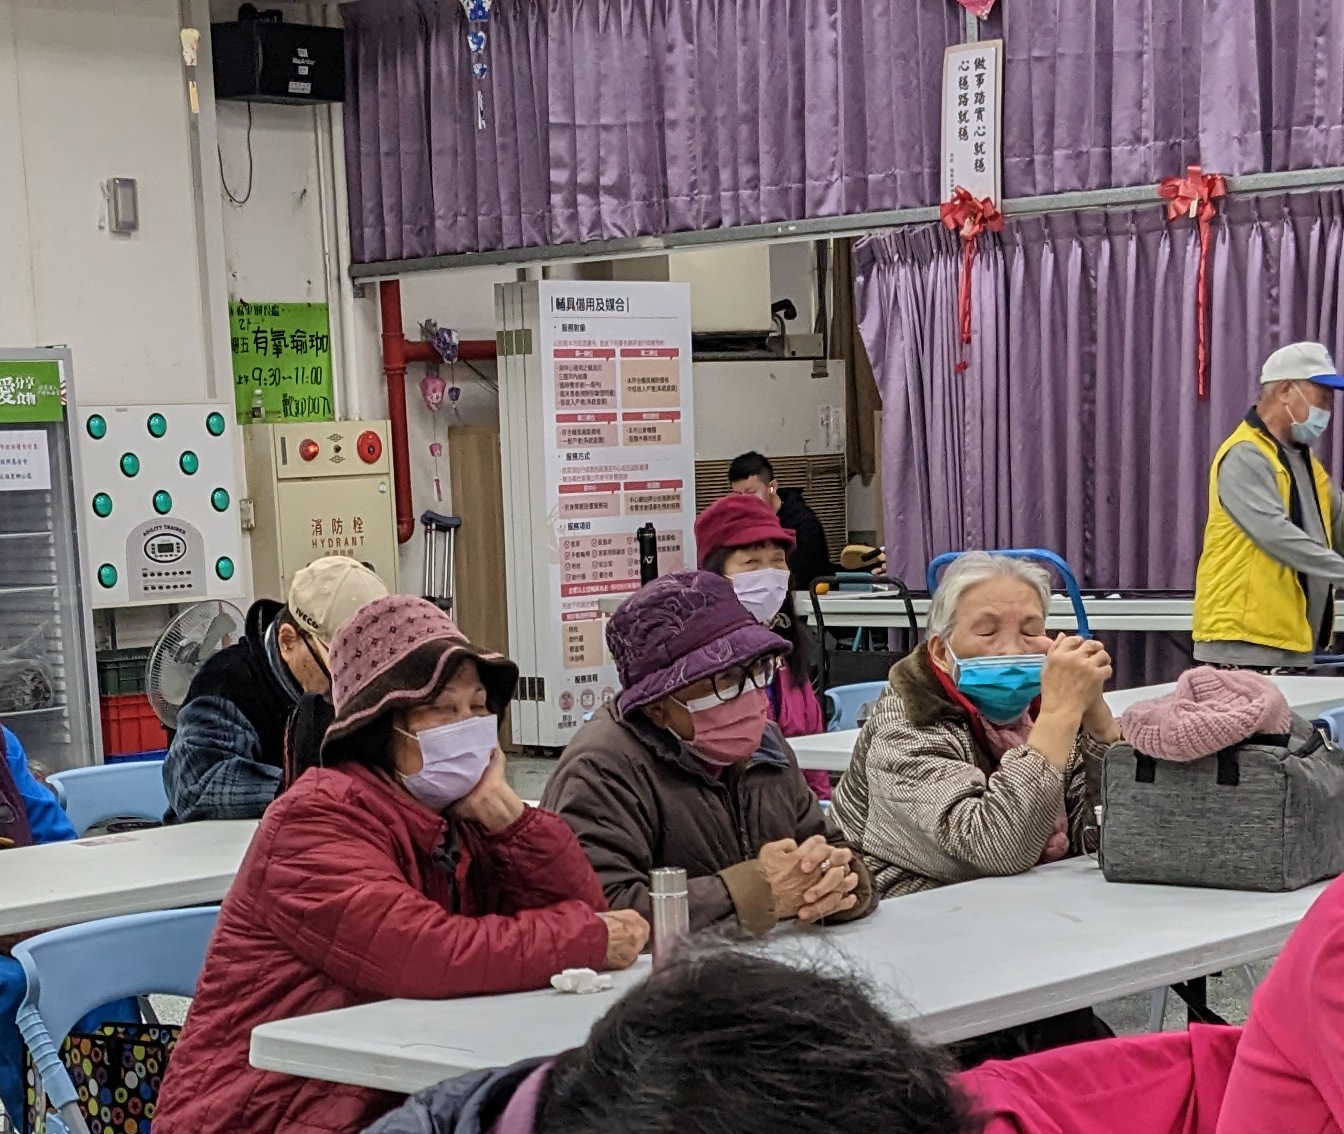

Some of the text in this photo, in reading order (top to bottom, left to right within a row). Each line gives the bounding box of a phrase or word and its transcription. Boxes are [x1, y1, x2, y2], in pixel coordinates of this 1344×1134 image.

[957, 60, 970, 142] 心穩路就穩
[973, 56, 987, 173] 做事踏實心就穩
[252, 325, 329, 358] 有氧瑜珈
[16, 376, 35, 390] 分享
[311, 516, 365, 537] 消防栓
[312, 536, 365, 549] HYDRANT
[296, 607, 319, 629] IVECO
